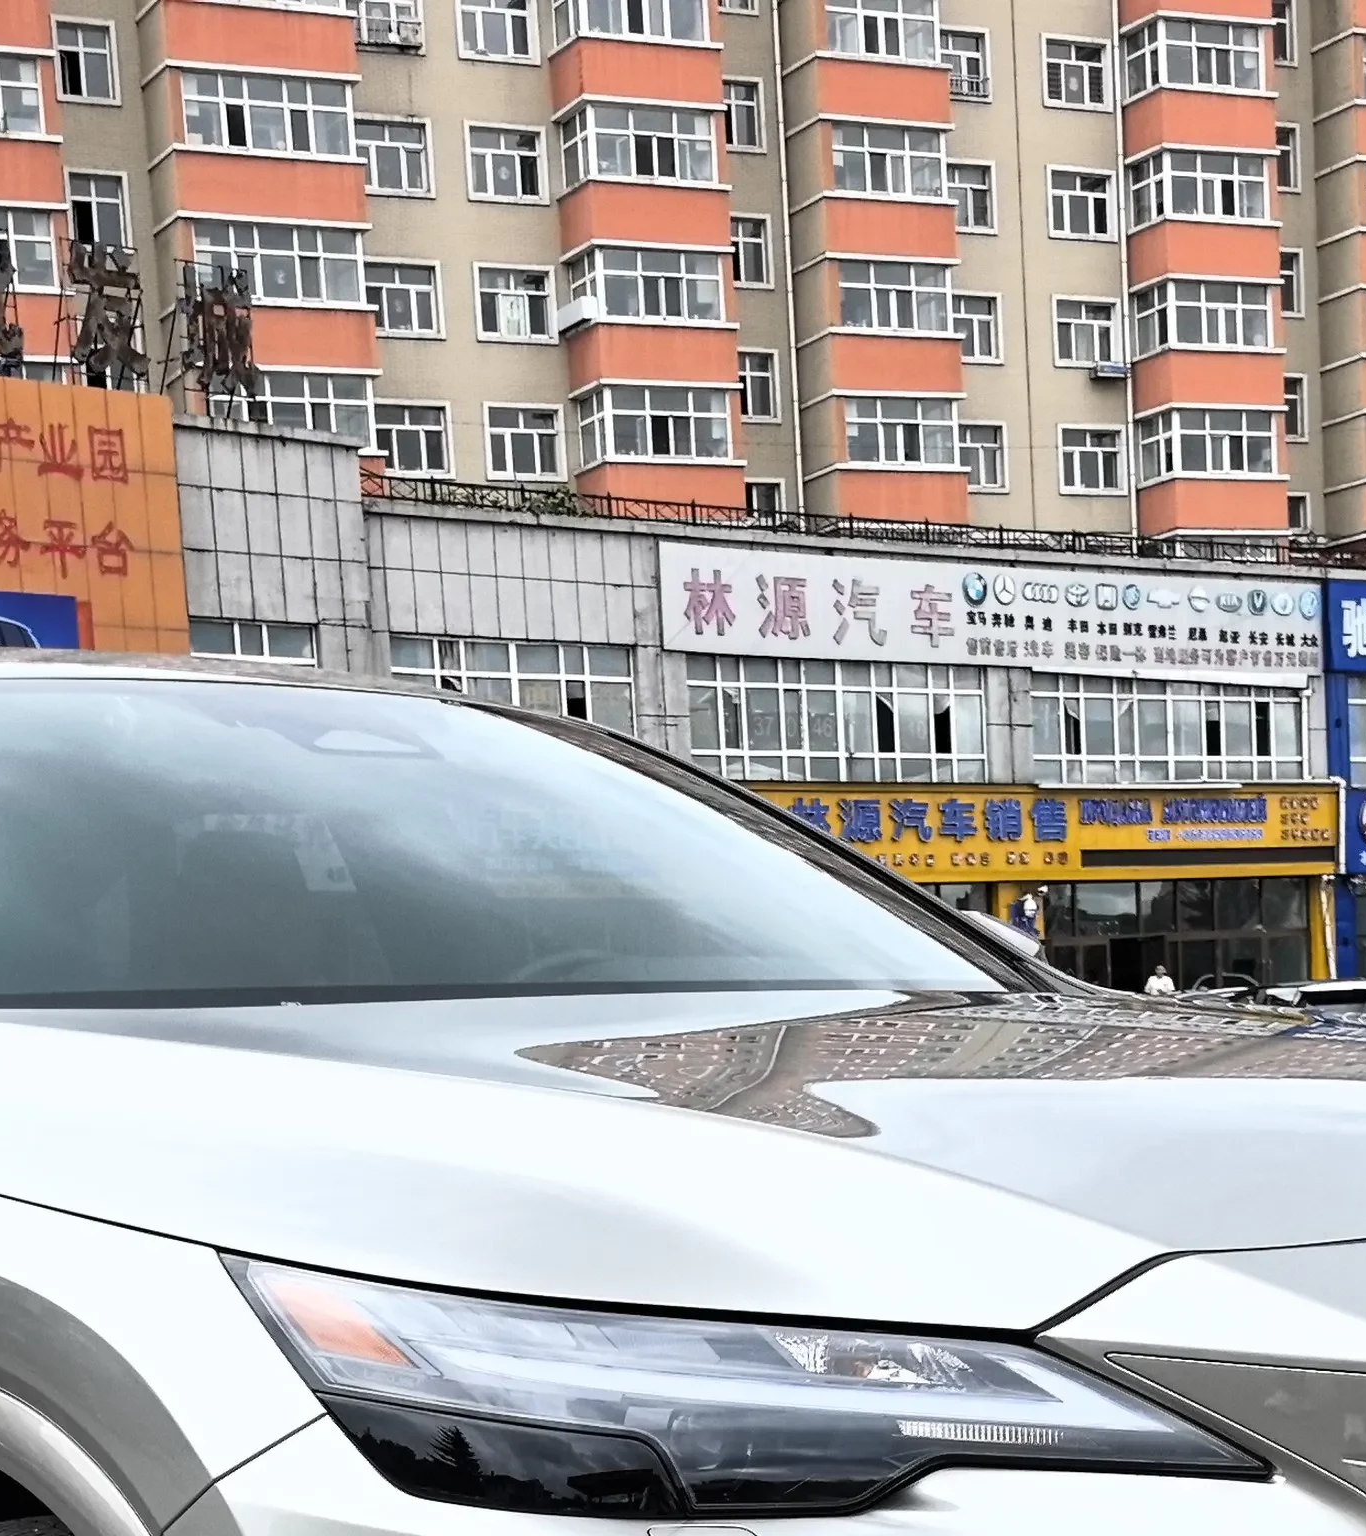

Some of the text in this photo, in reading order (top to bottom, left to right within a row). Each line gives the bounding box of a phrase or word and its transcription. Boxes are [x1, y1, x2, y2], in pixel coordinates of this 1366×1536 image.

[683, 567, 956, 648] 林源汽车
[966, 610, 987, 626] 宝马
[1067, 618, 1090, 633] 丰田
[788, 796, 1069, 844] 林源汽车销售
